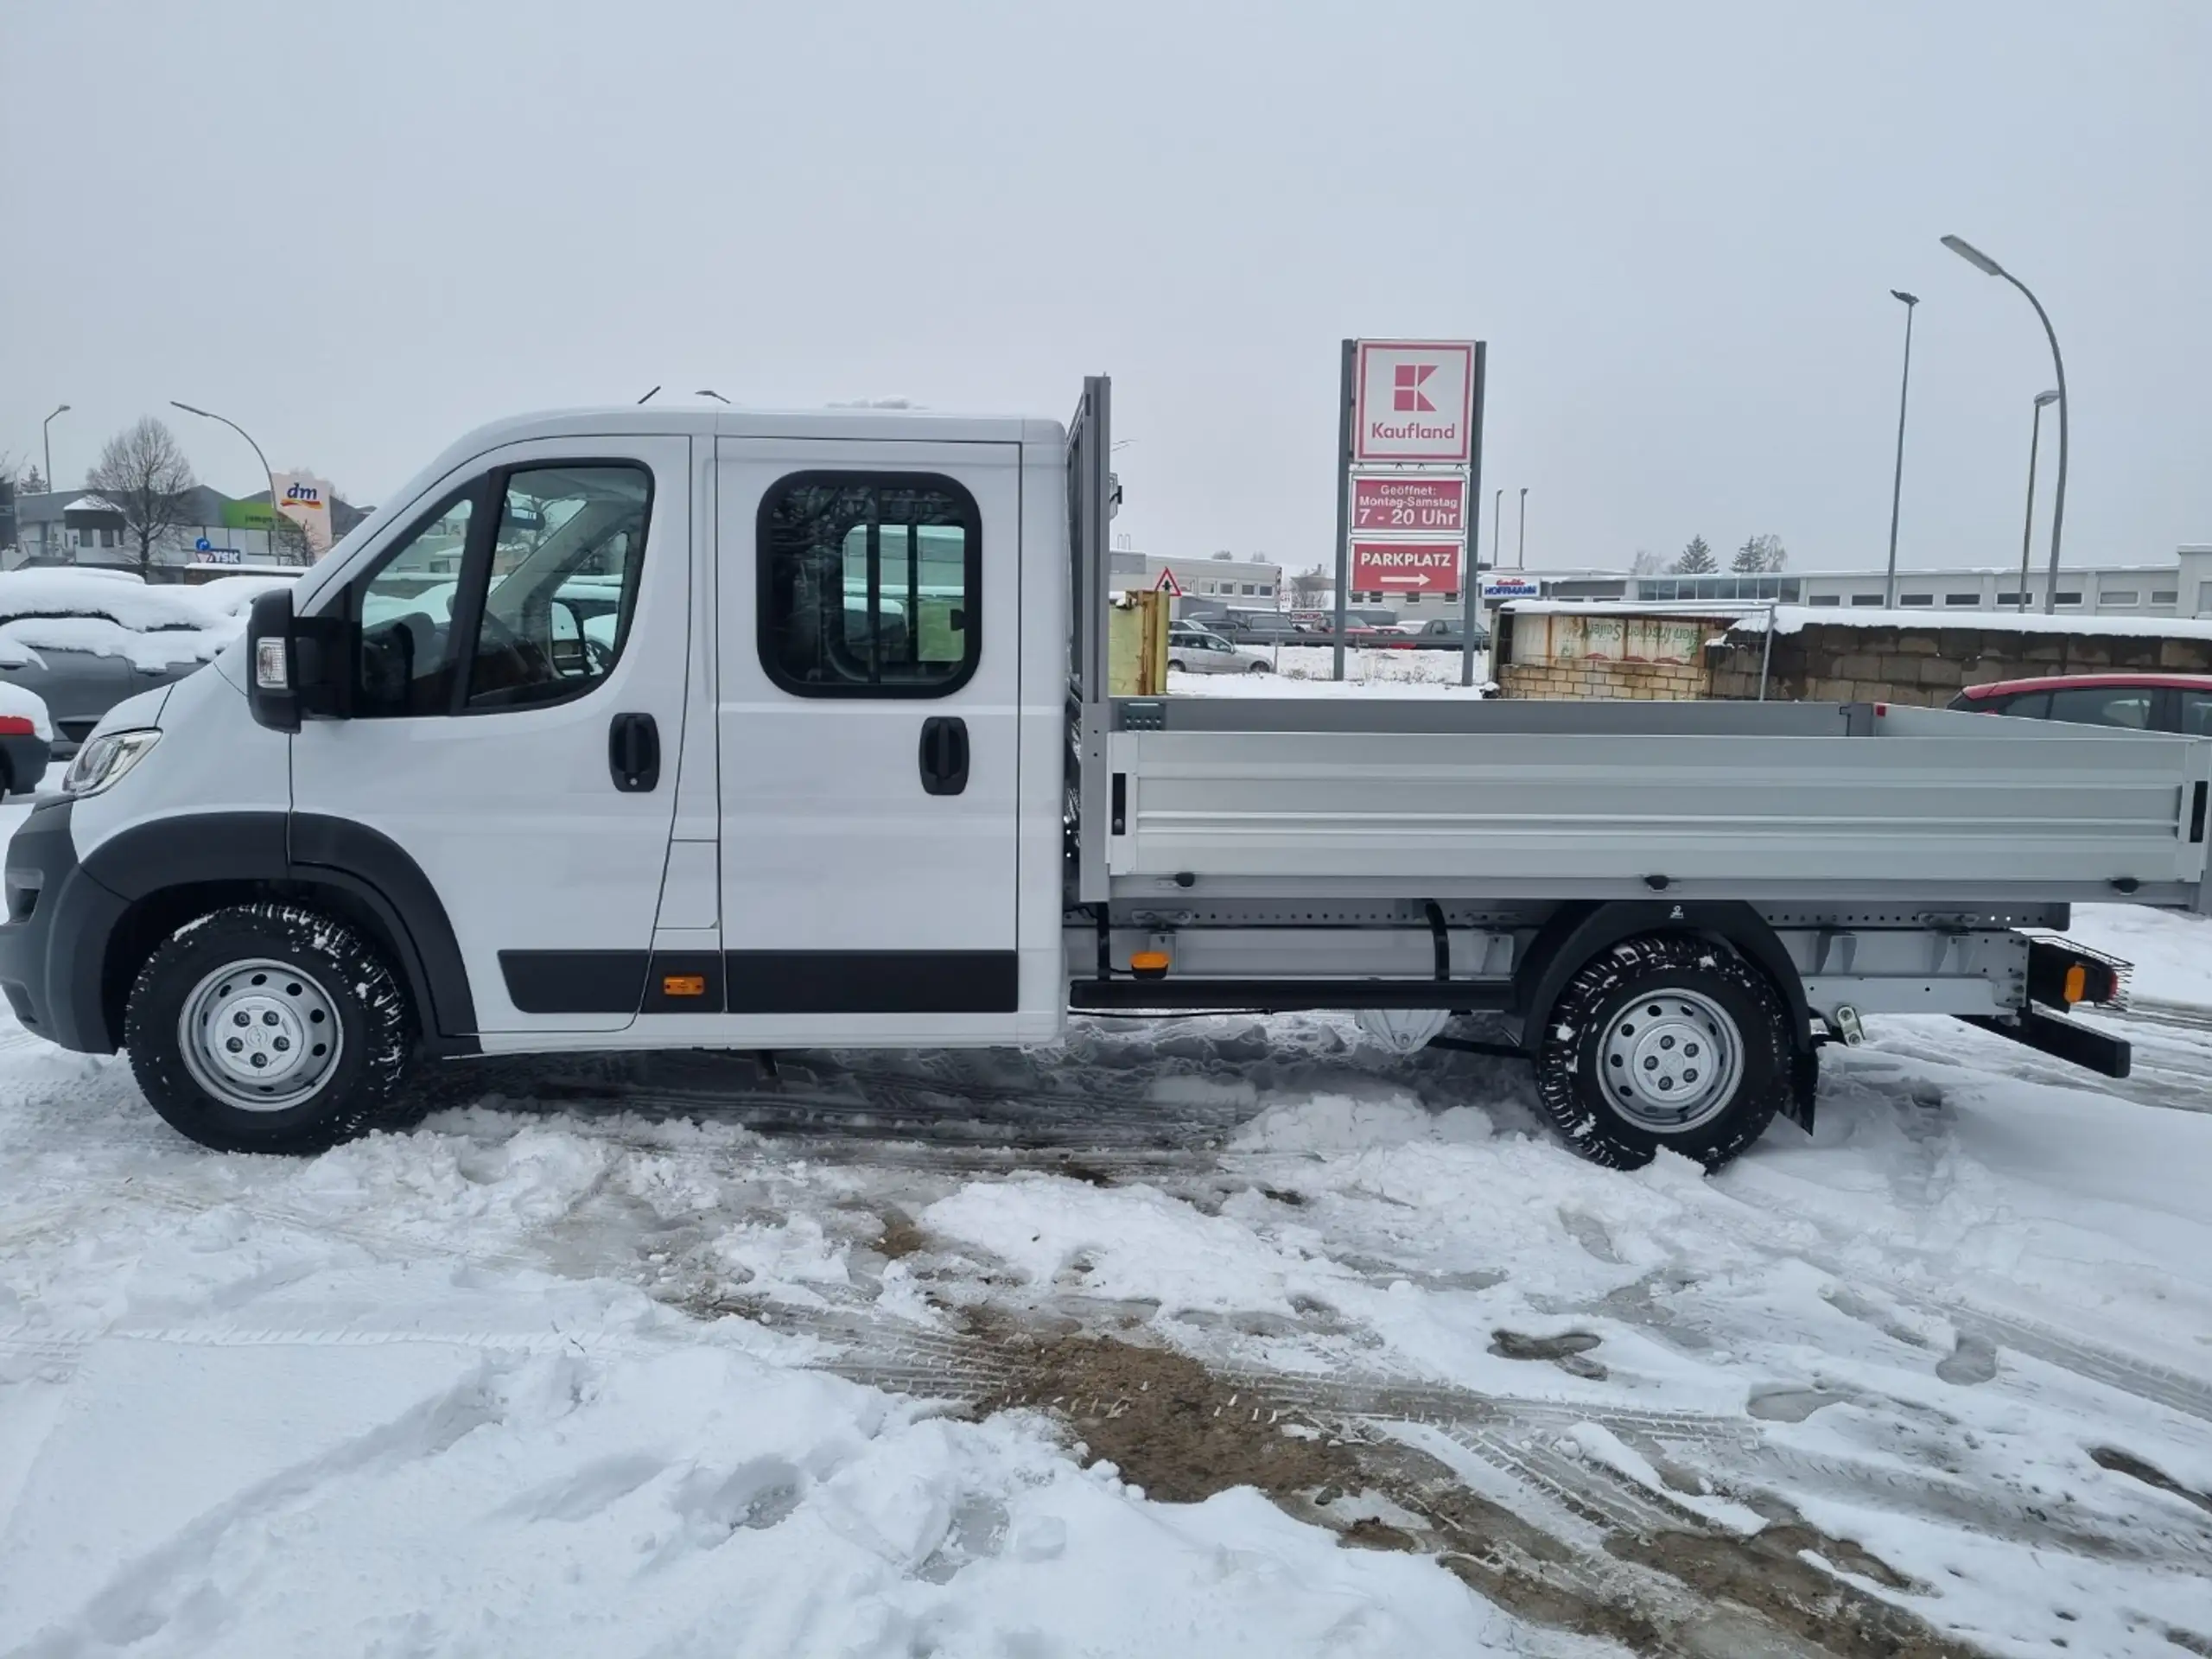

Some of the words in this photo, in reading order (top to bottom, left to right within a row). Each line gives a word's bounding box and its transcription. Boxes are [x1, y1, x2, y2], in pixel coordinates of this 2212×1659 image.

[1371, 423, 1455, 439] Kaufland
[287, 482, 317, 499] dm
[1381, 485, 1437, 496] Geöffnet:
[1359, 496, 1459, 508] Montag-Samstag
[1359, 509, 1371, 524] 7
[1390, 509, 1415, 524] 20
[1422, 509, 1457, 524] Uhr
[1360, 552, 1452, 567] PARKPLATZ
